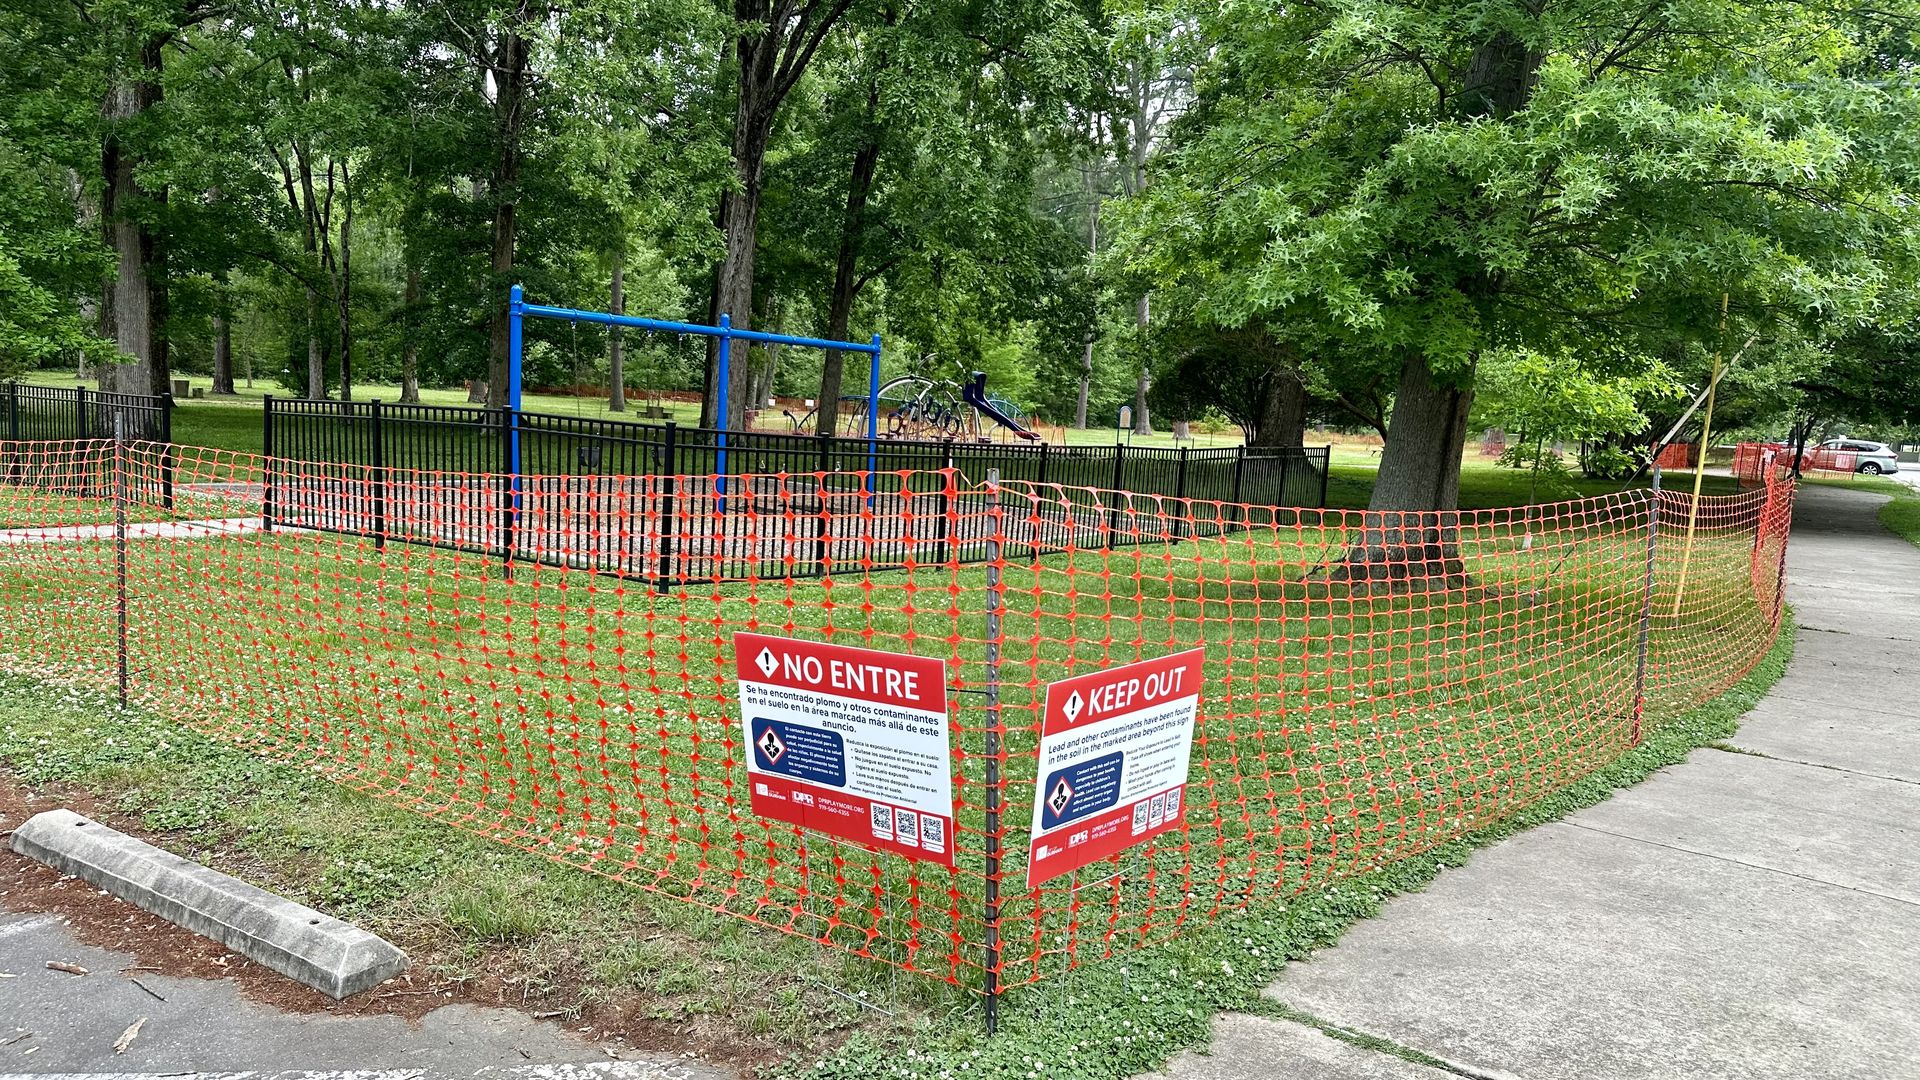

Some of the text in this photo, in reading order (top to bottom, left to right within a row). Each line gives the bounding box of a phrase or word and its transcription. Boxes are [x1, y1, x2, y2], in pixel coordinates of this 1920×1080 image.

[784, 654, 918, 699] NO ENTRE
[1089, 666, 1186, 715] KEEP OUT
[746, 685, 756, 694] Se
[758, 687, 768, 695] ha
[770, 690, 814, 703] encontrado
[816, 697, 841, 708] plomo
[850, 704, 871, 714] otros
[874, 709, 938, 725] contaminantes
[768, 700, 789, 709] suelo
[802, 704, 809, 713] la
[831, 712, 866, 723] marcada
[869, 718, 886, 727] más
[889, 721, 903, 730] allá
[906, 724, 917, 733] de
[920, 728, 939, 736] este
[822, 721, 856, 732] anuncio.
[1049, 705, 1191, 754] Lead and other contaminants have been found
[1057, 754, 1068, 762] the
[1070, 748, 1081, 758] soil
[1090, 743, 1101, 752] the
[1103, 735, 1126, 748] marked
[1128, 731, 1141, 740] area
[1143, 723, 1164, 736] beyond
[1166, 721, 1176, 729] this
[1177, 717, 1188, 726] sign
[794, 791, 813, 804] DPR
[1070, 830, 1088, 844] DPR
